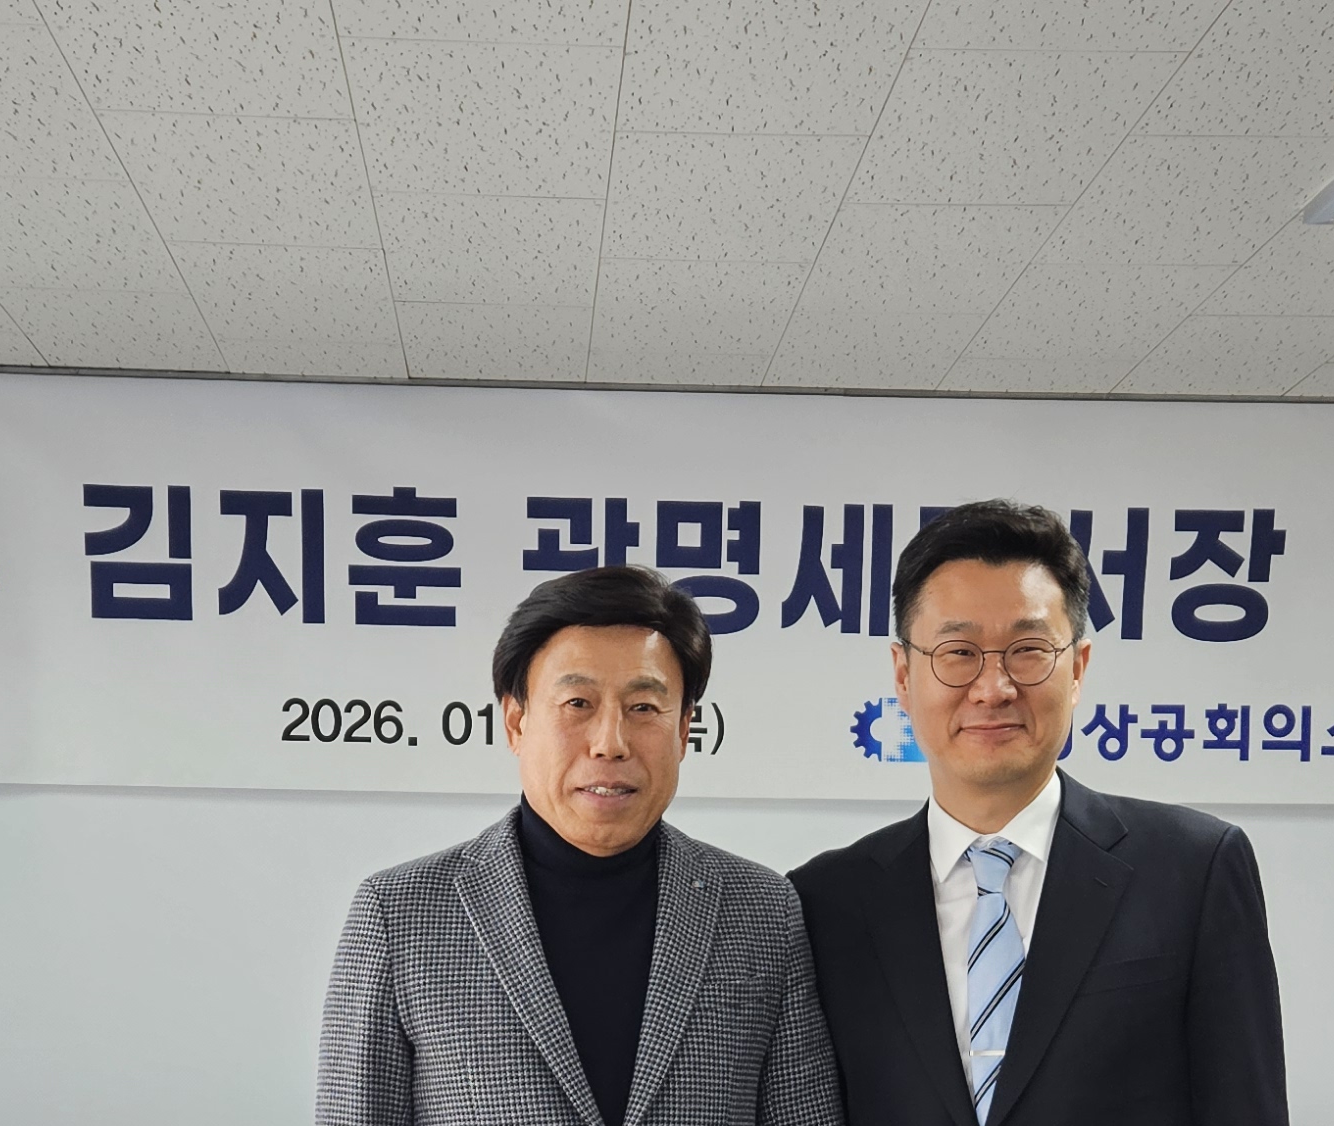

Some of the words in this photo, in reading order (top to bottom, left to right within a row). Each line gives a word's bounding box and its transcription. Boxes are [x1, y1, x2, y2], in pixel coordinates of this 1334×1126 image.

[82, 483, 462, 627] 김지훈
[522, 496, 1287, 643] 광명세서장
[280, 697, 419, 747] 2026.
